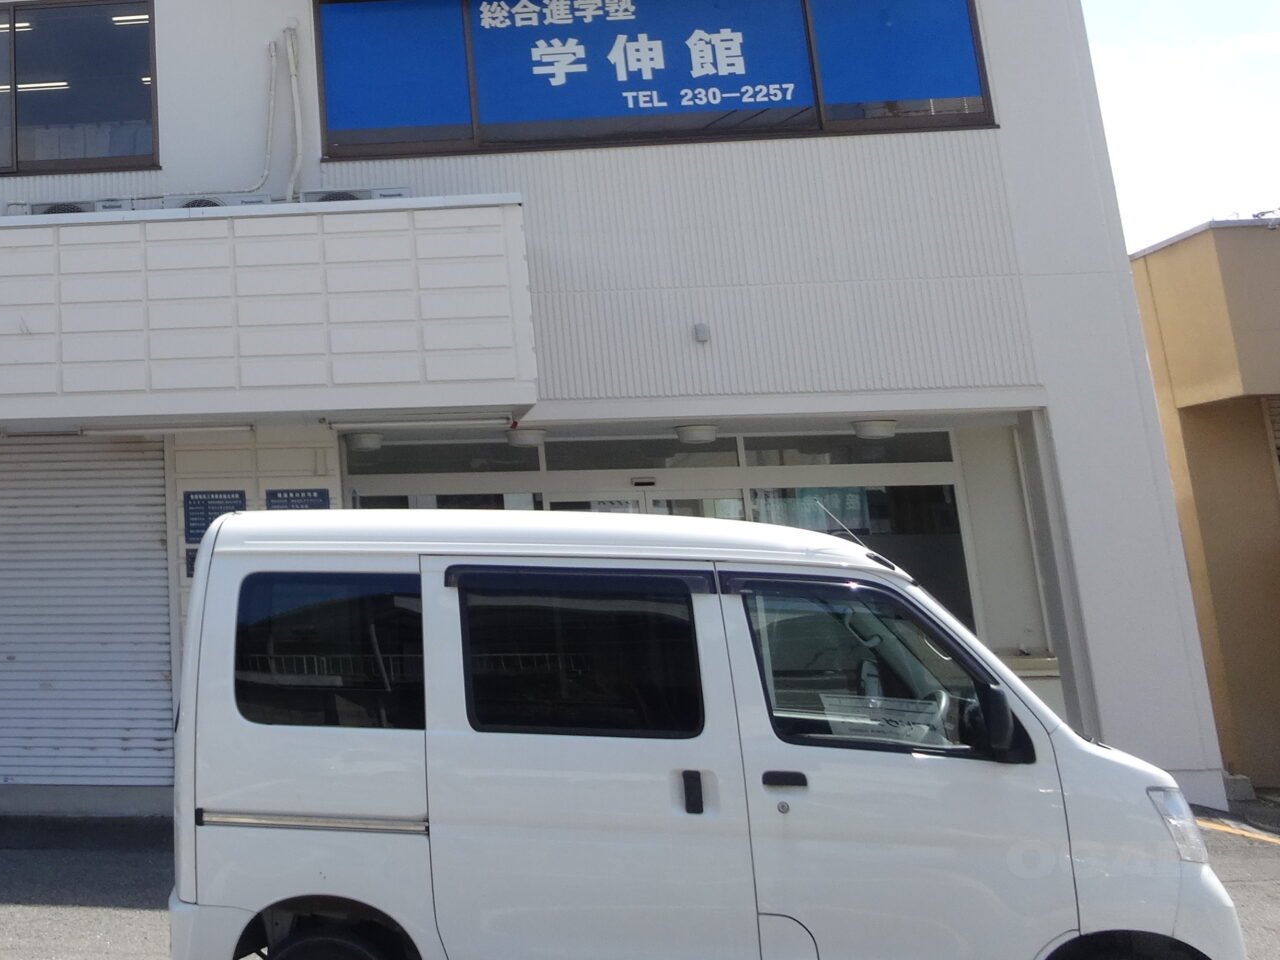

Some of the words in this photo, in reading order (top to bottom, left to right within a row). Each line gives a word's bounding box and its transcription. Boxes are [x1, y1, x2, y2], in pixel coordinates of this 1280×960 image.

[531, 29, 745, 86] 学伸館
[622, 90, 667, 109] TEL
[680, 83, 795, 107] 230-2257
